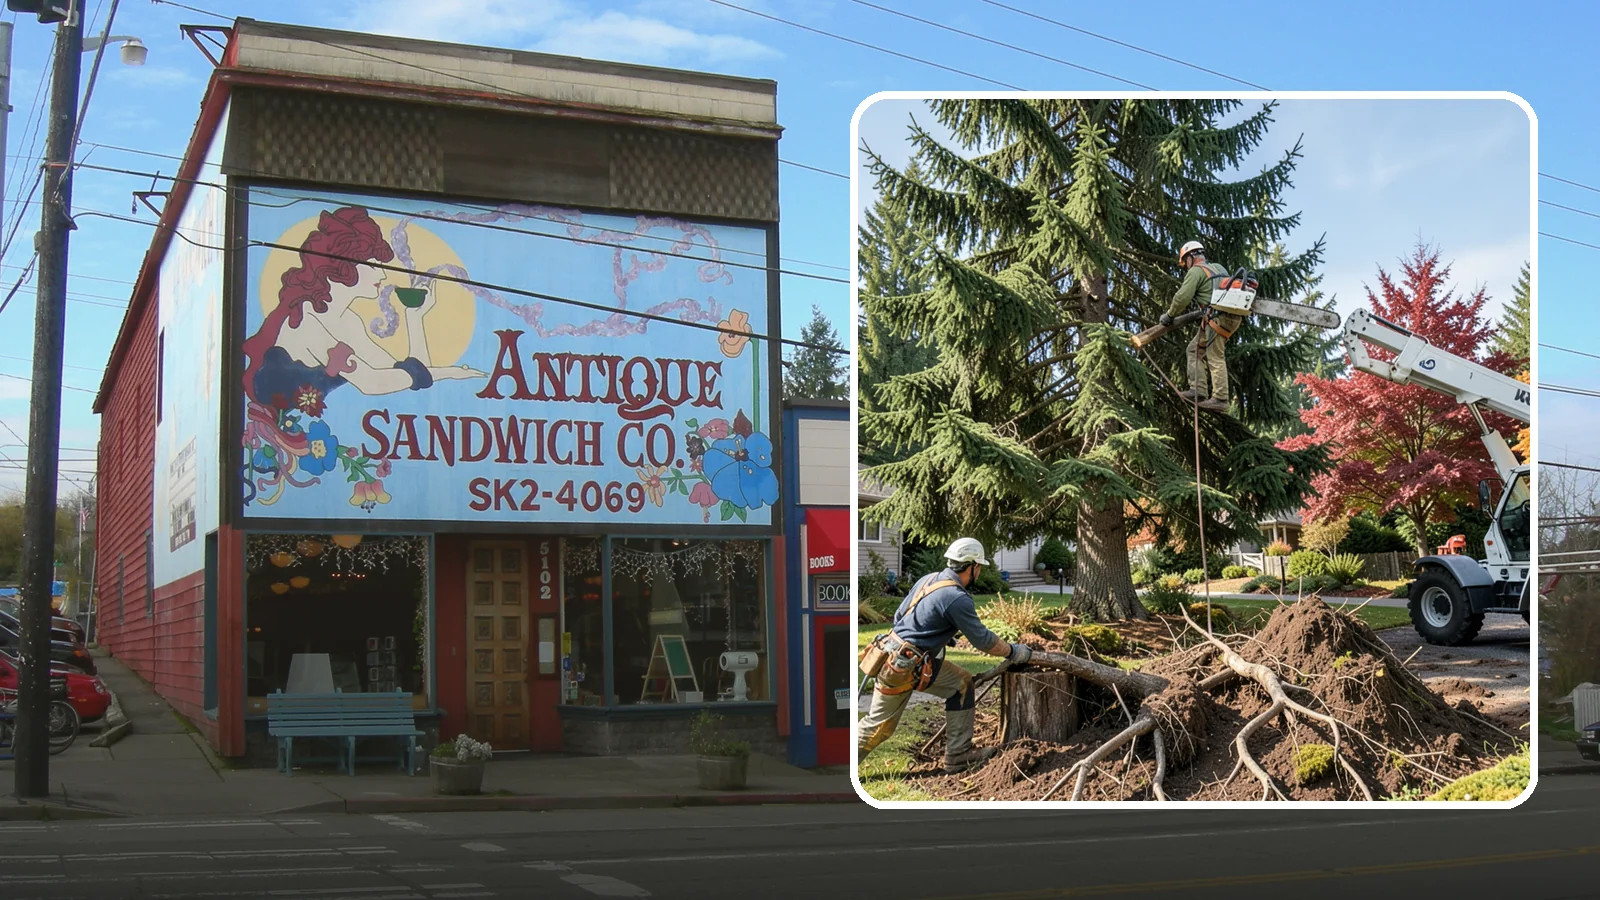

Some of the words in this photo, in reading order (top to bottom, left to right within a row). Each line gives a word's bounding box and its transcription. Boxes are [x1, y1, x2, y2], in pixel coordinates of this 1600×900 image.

[476, 329, 723, 421] ANTIQUE
[361, 408, 604, 467] SANDWICH
[617, 422, 684, 469] CO.
[469, 478, 646, 513] SK2-4069
[540, 541, 551, 599] 5102
[810, 555, 834, 569] BOOKS
